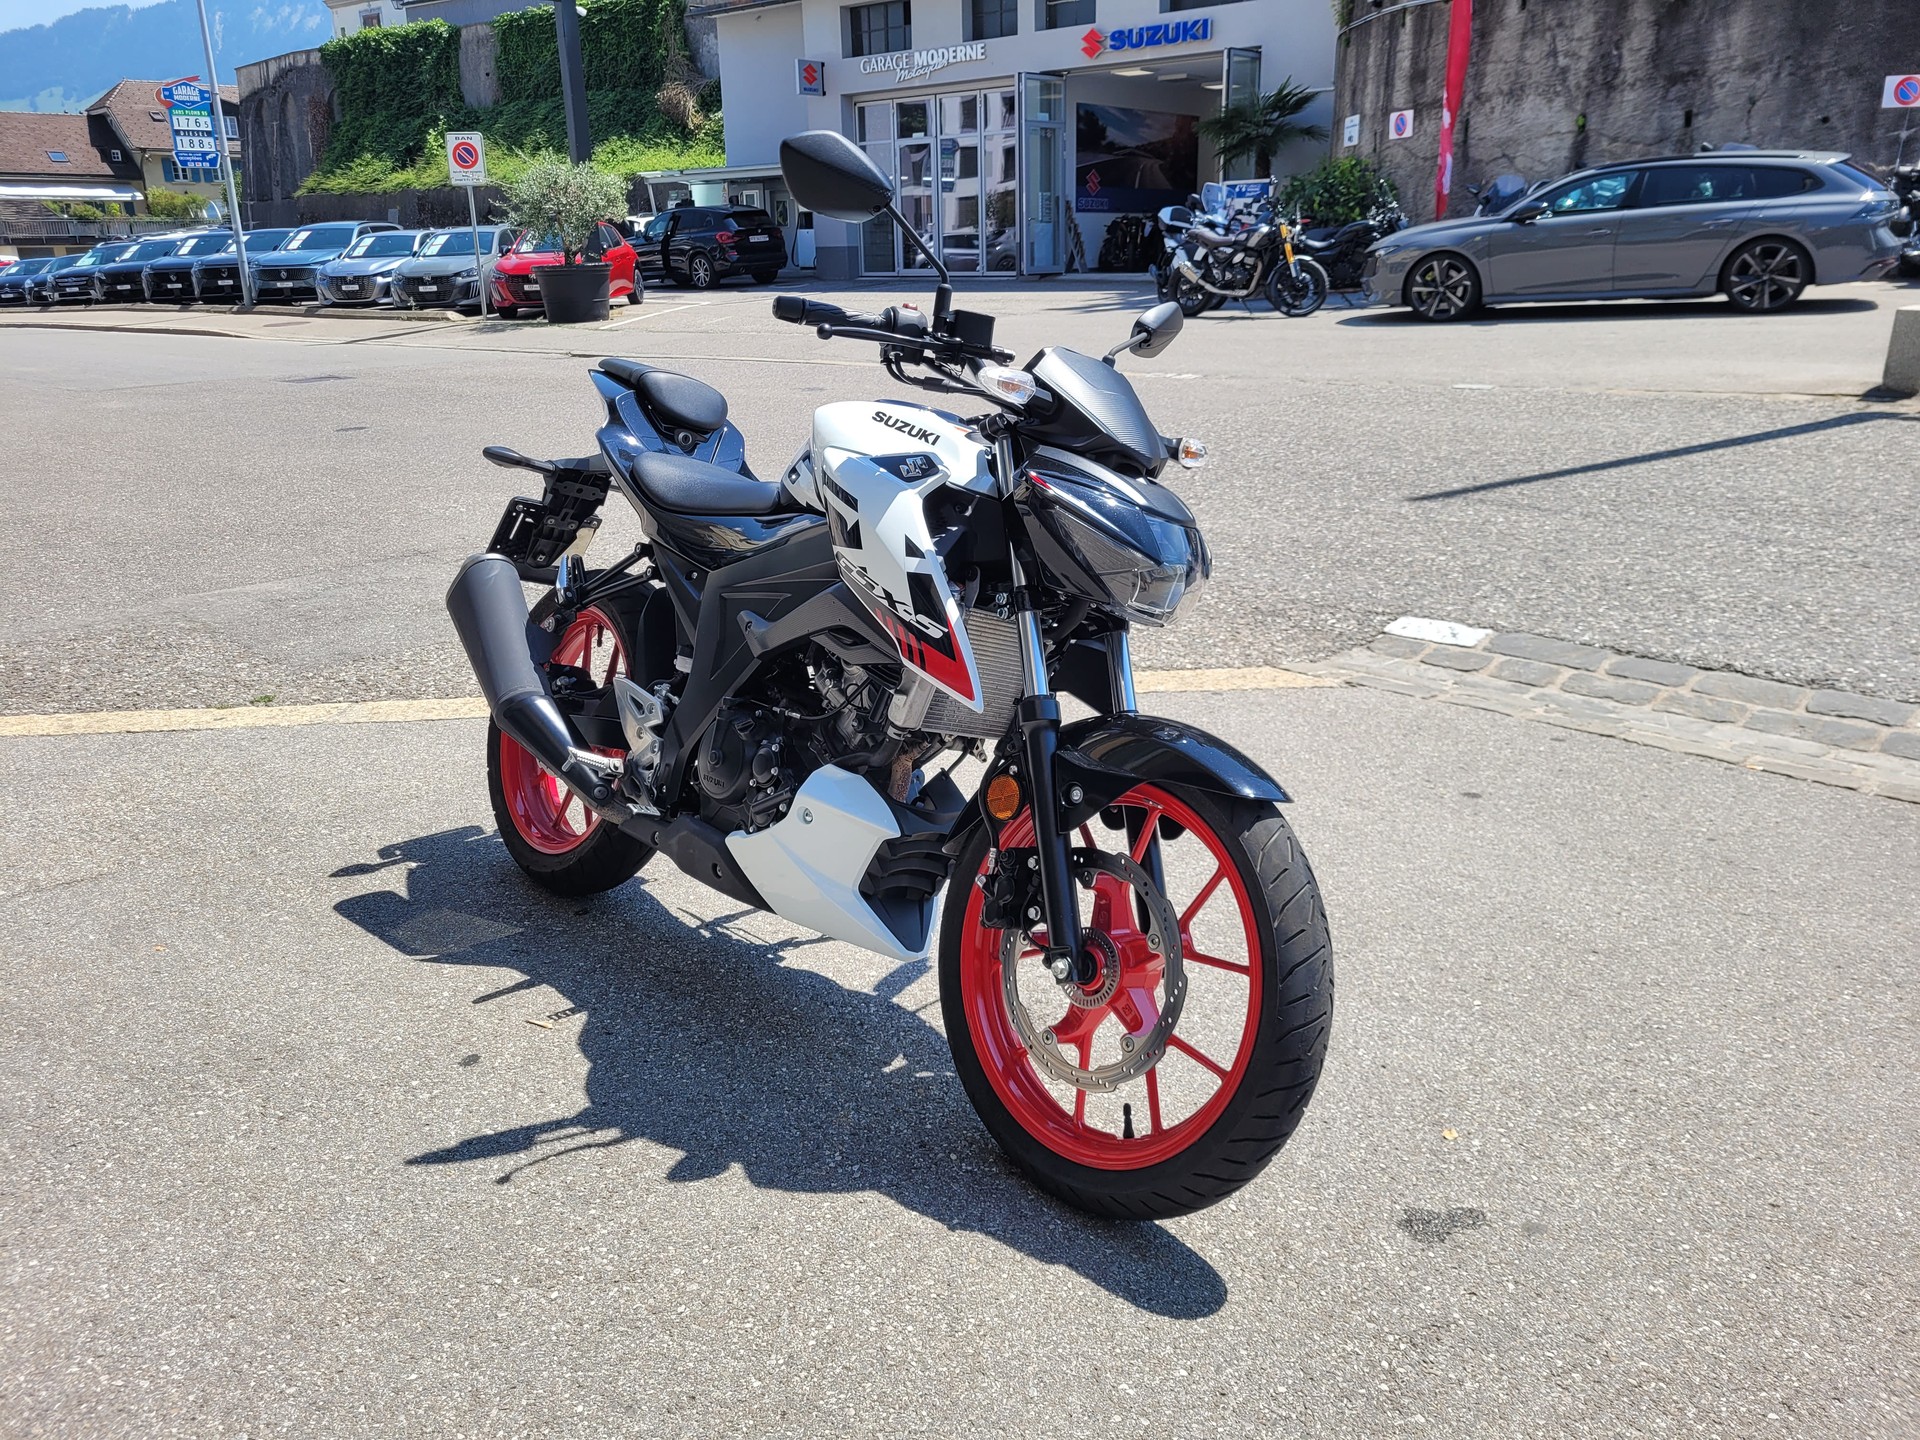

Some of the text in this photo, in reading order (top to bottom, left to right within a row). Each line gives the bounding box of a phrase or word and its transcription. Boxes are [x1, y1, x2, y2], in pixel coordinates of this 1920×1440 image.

[1109, 18, 1210, 51] SUZUKI
[860, 43, 986, 74] GARAGE MODERNE
[172, 86, 200, 95] GARAGE
[1078, 197, 1109, 210] SUZUKI
[872, 411, 940, 446] SUZUKI
[703, 774, 725, 788] SUZUKI
